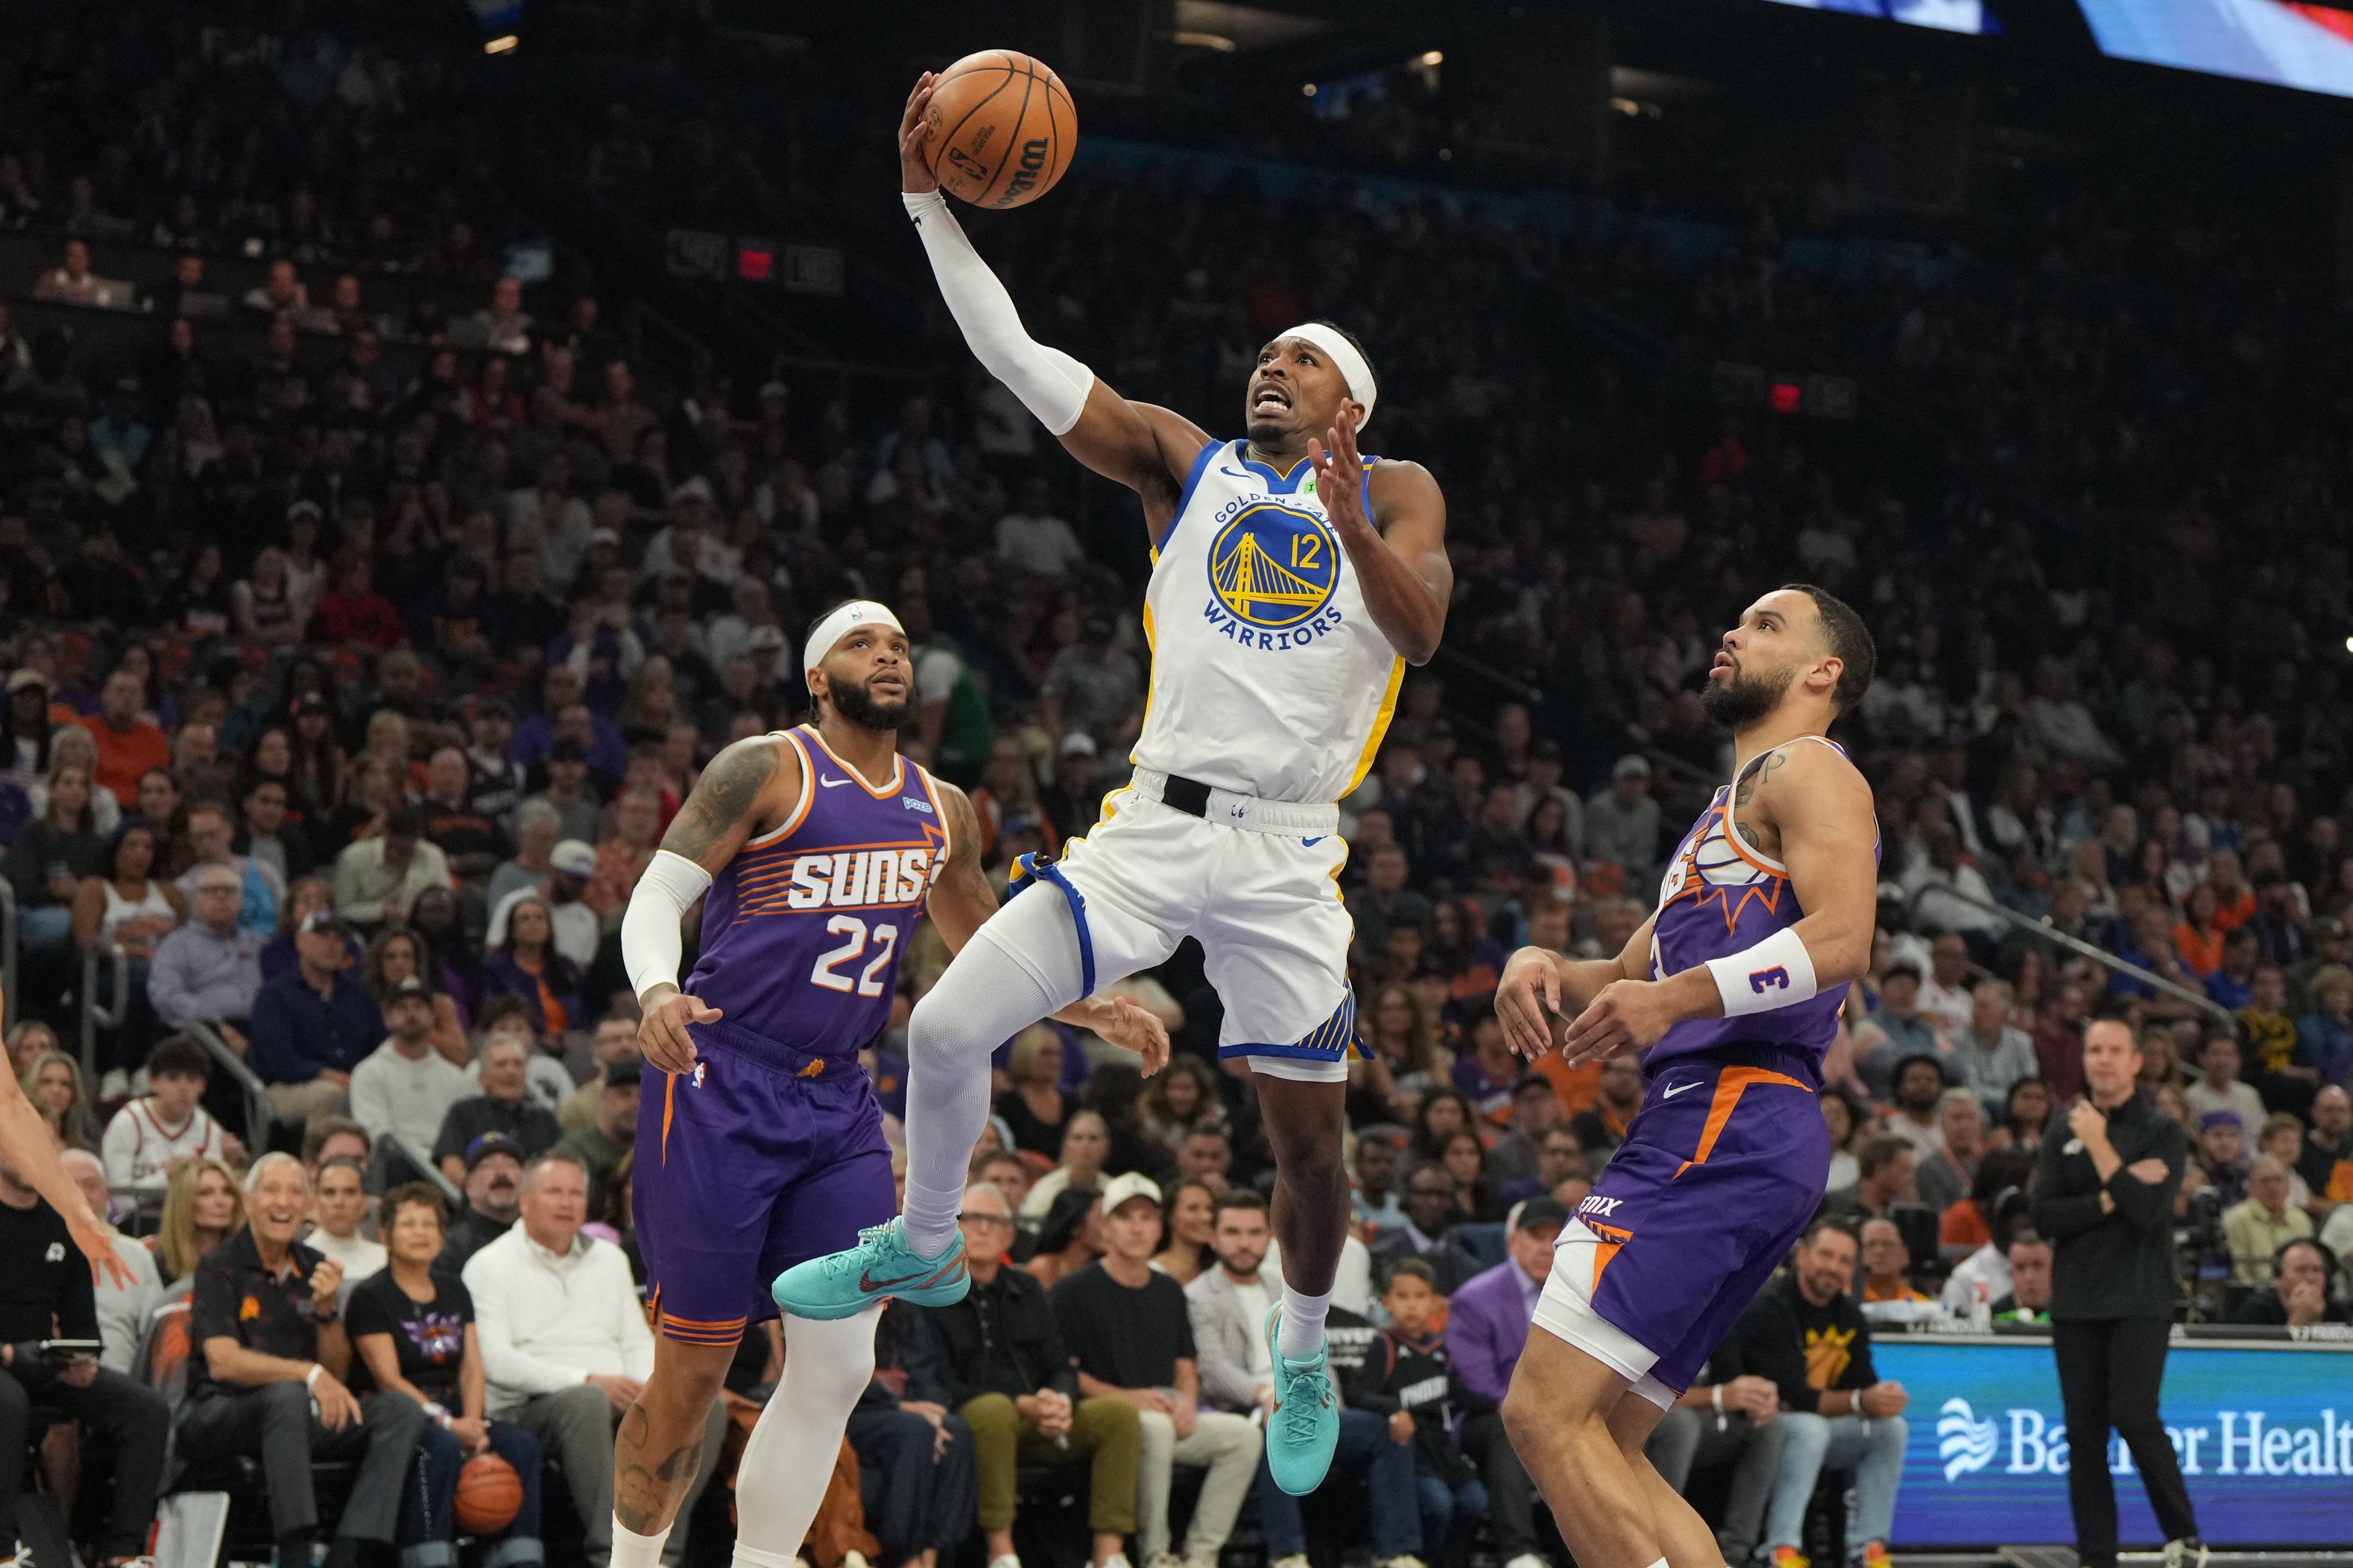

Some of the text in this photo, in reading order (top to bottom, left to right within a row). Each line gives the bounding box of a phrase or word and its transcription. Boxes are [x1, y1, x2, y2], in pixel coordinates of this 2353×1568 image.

[1215, 493, 1286, 523] GOLDEN
[1291, 534, 1321, 569] 12
[1203, 598, 1342, 651] WARRIORS
[904, 797, 932, 813] paze
[787, 849, 929, 908] SUNS
[810, 914, 898, 997] 22
[1749, 963, 1790, 994] 3
